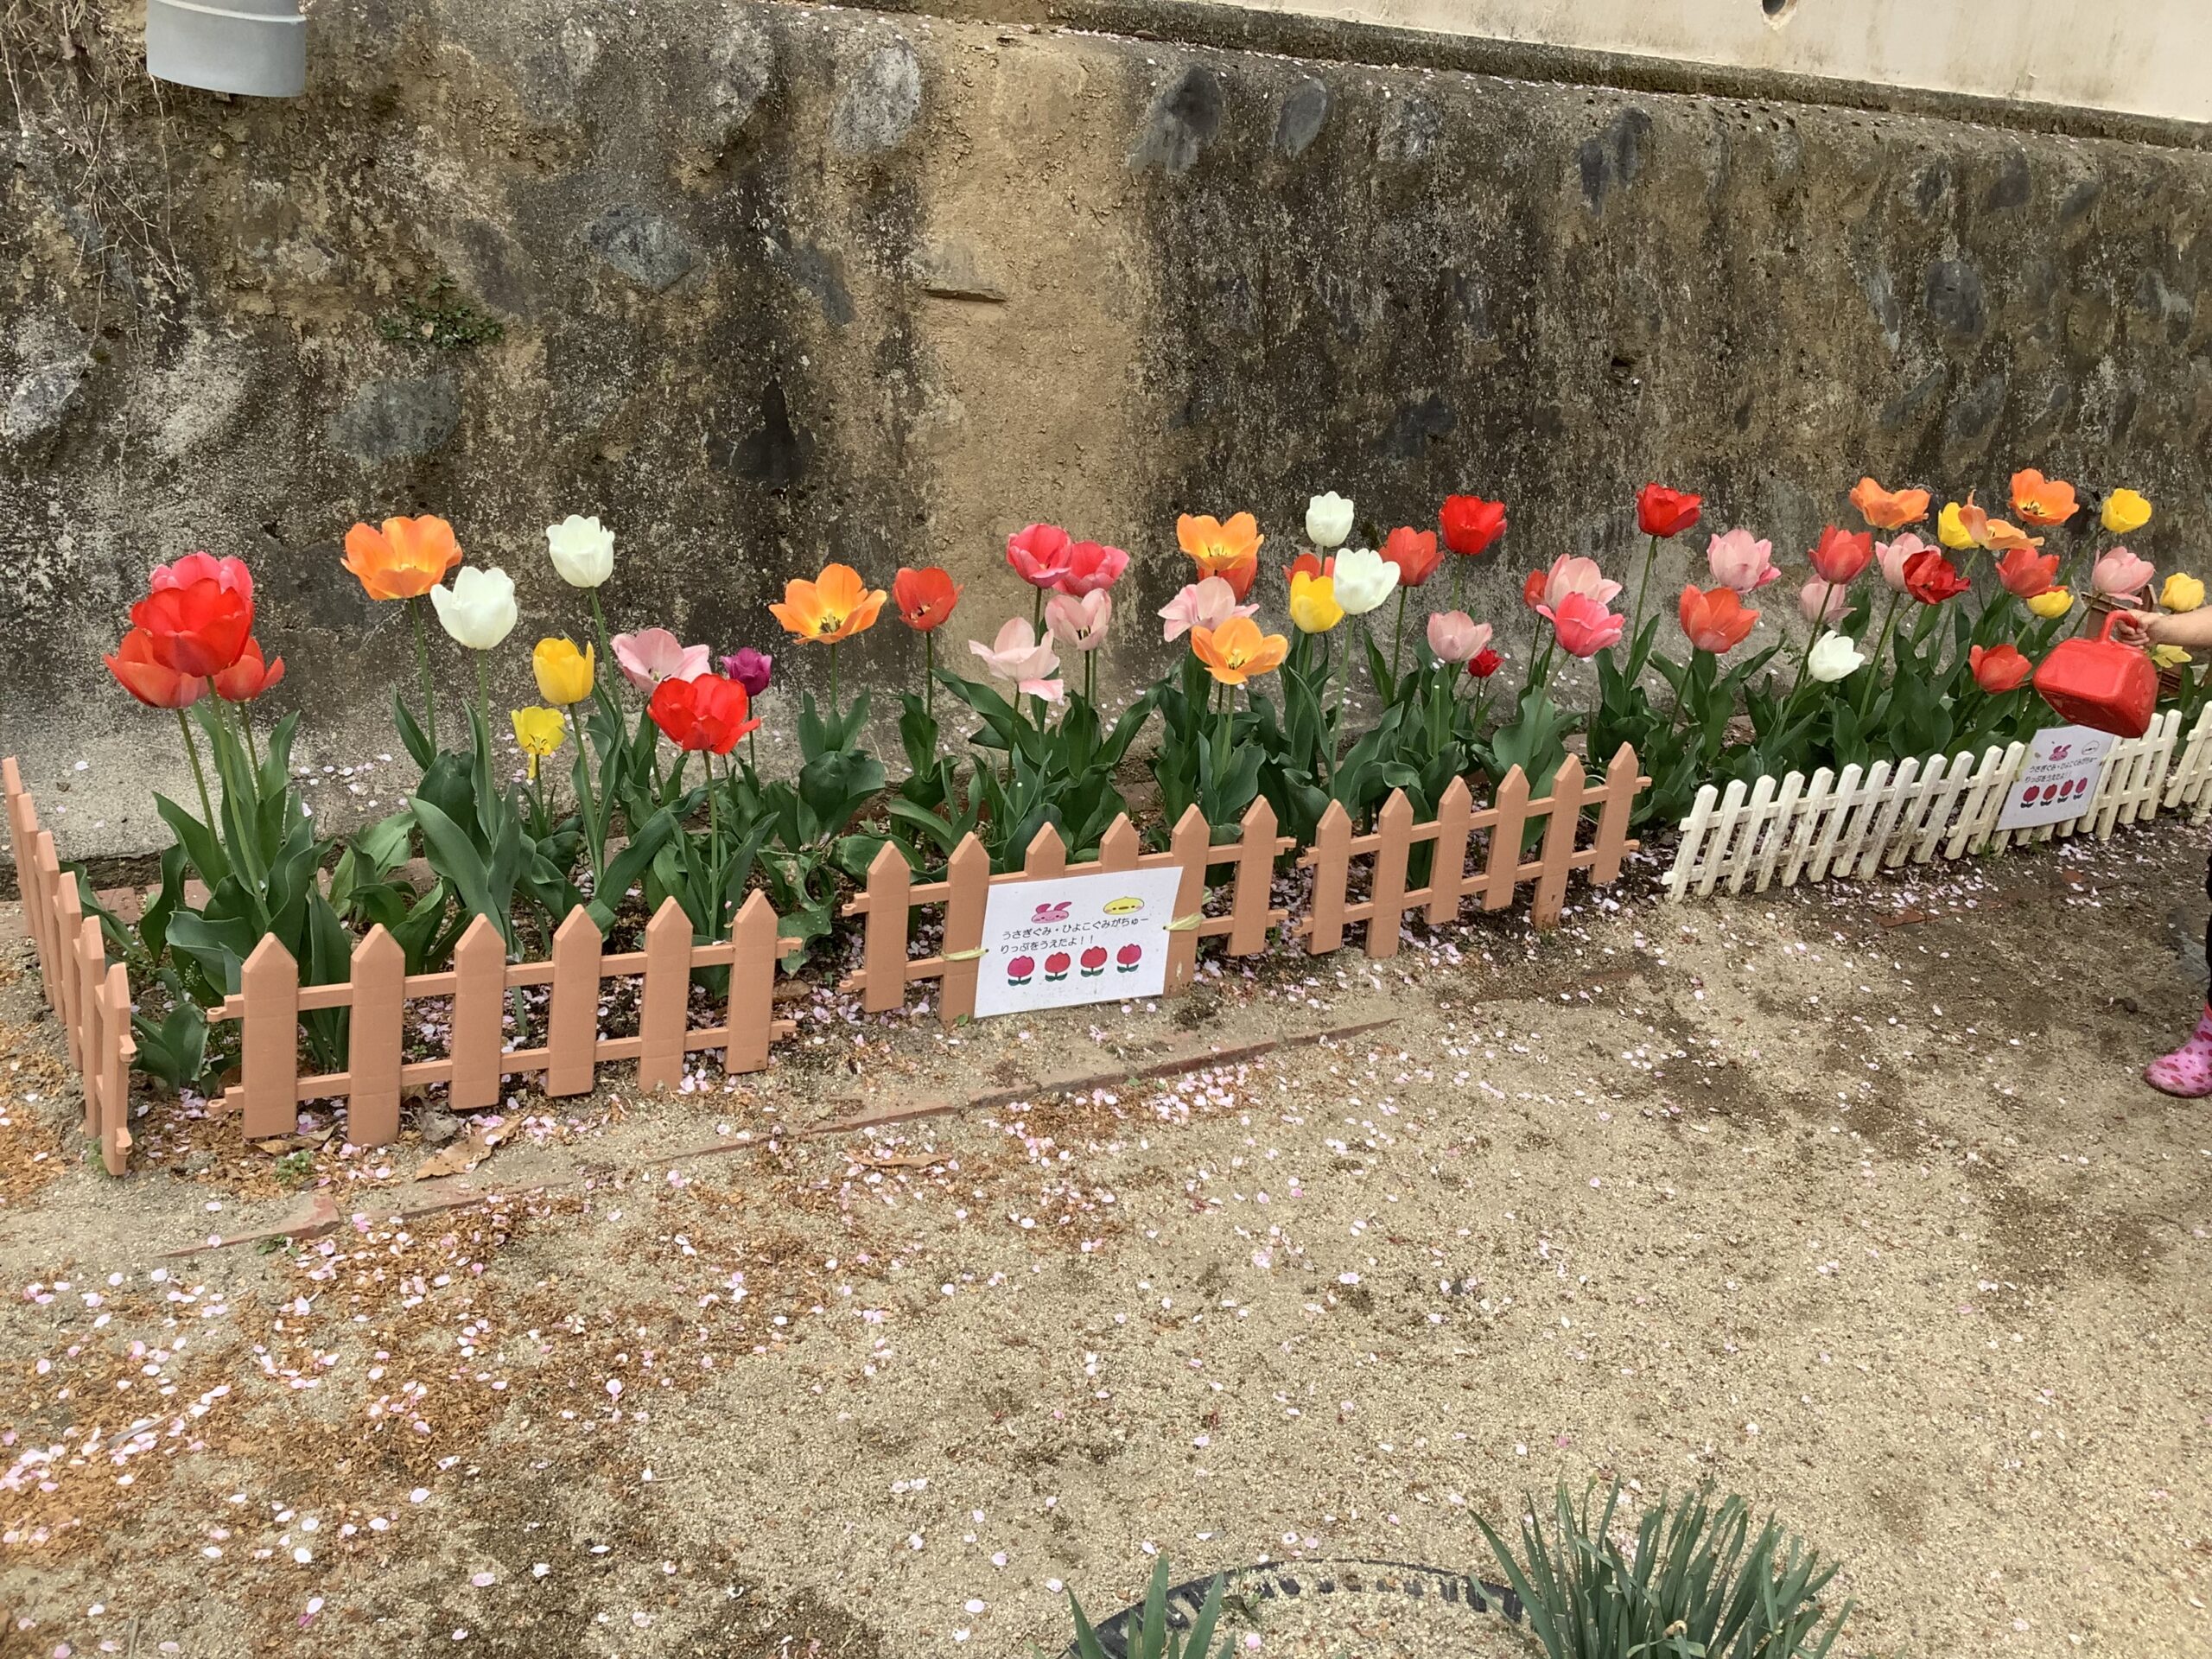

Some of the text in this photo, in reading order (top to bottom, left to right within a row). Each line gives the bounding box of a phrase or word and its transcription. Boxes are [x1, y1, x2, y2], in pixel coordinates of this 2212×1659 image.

[1002, 918, 1148, 940] うさぎぐみ・ひよこぐみがちゅー
